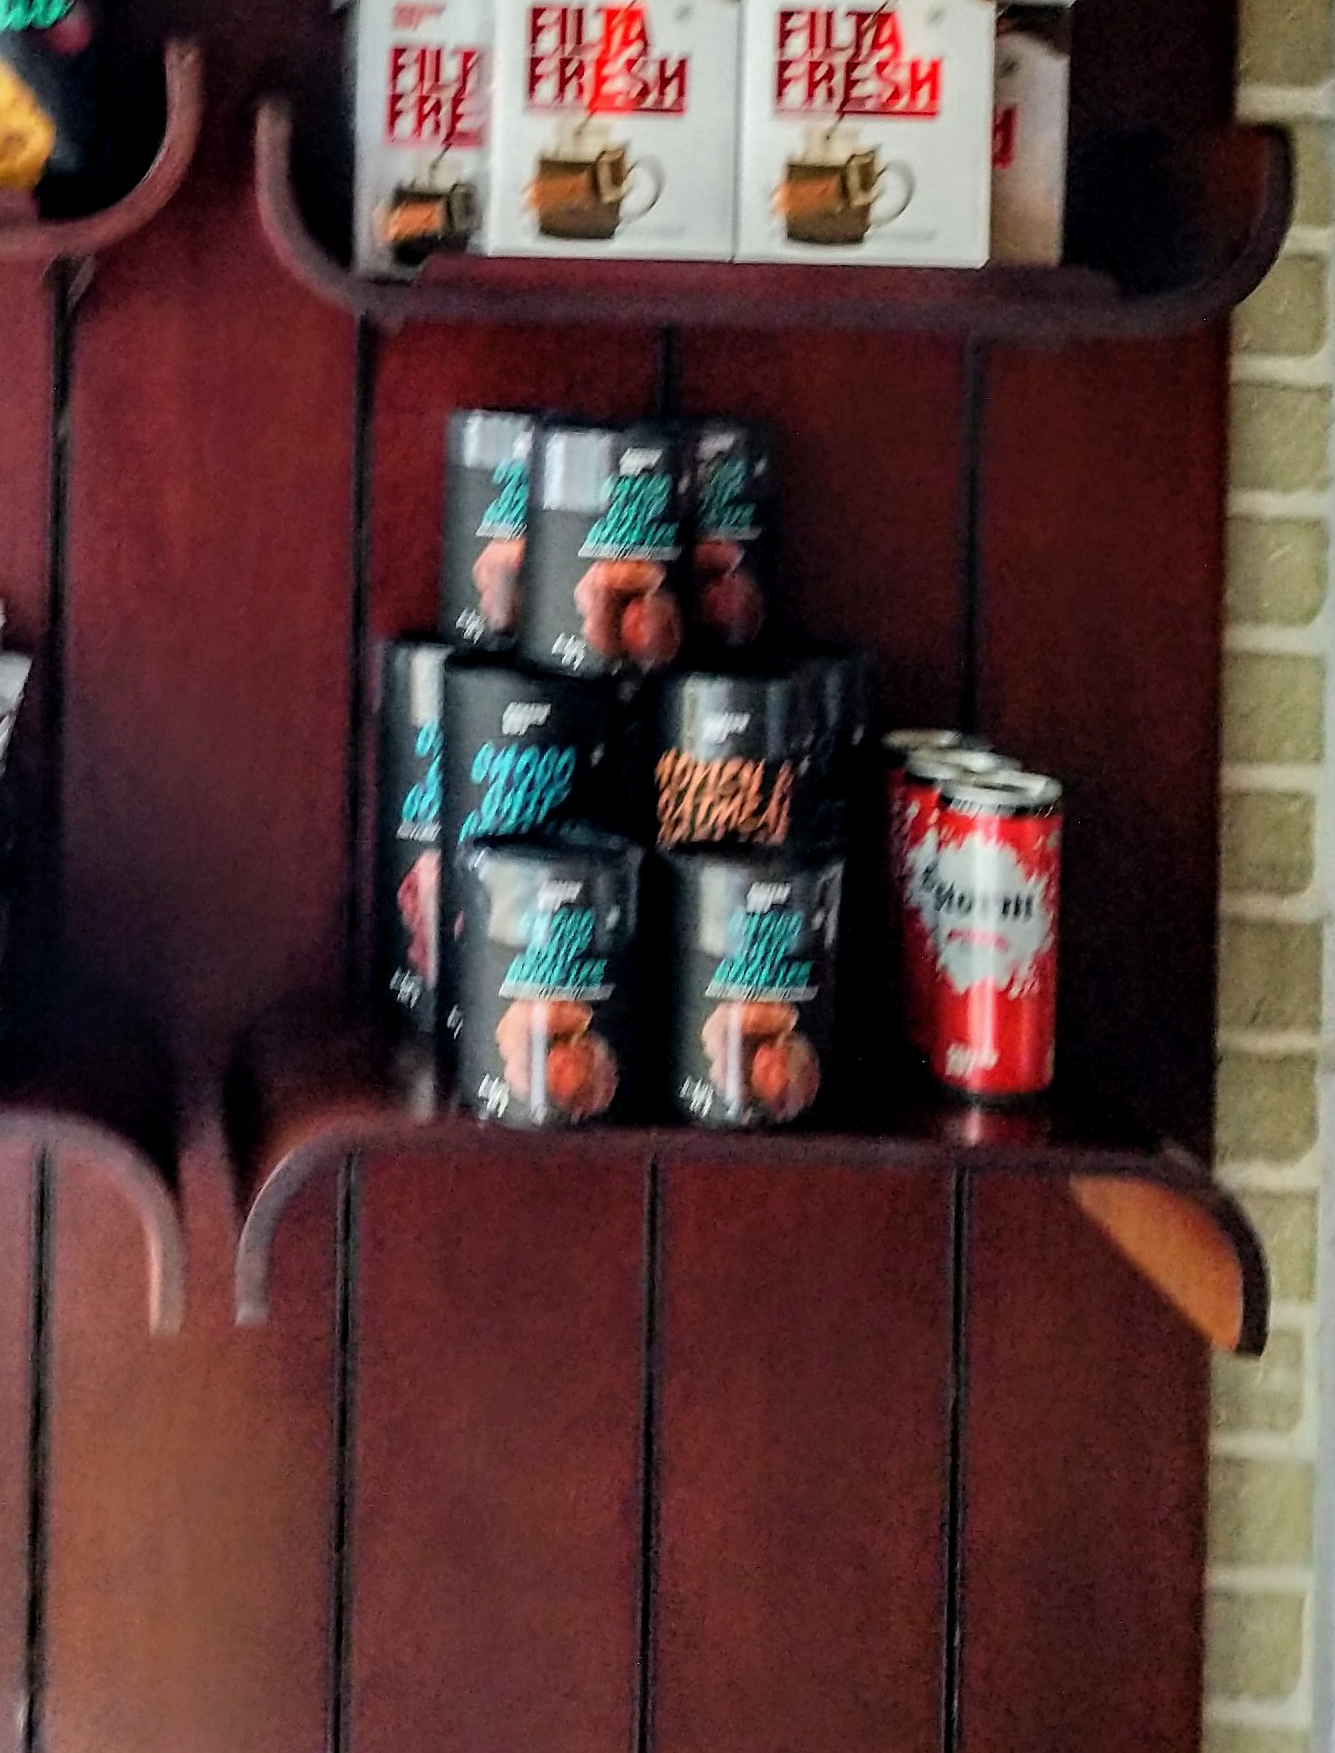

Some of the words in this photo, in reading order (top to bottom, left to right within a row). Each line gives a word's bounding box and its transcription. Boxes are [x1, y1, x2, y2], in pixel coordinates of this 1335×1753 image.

[529, 6, 650, 54] FILTA
[776, 9, 905, 58] FILTA
[527, 54, 689, 113] FRESH
[775, 58, 944, 118] FRESH
